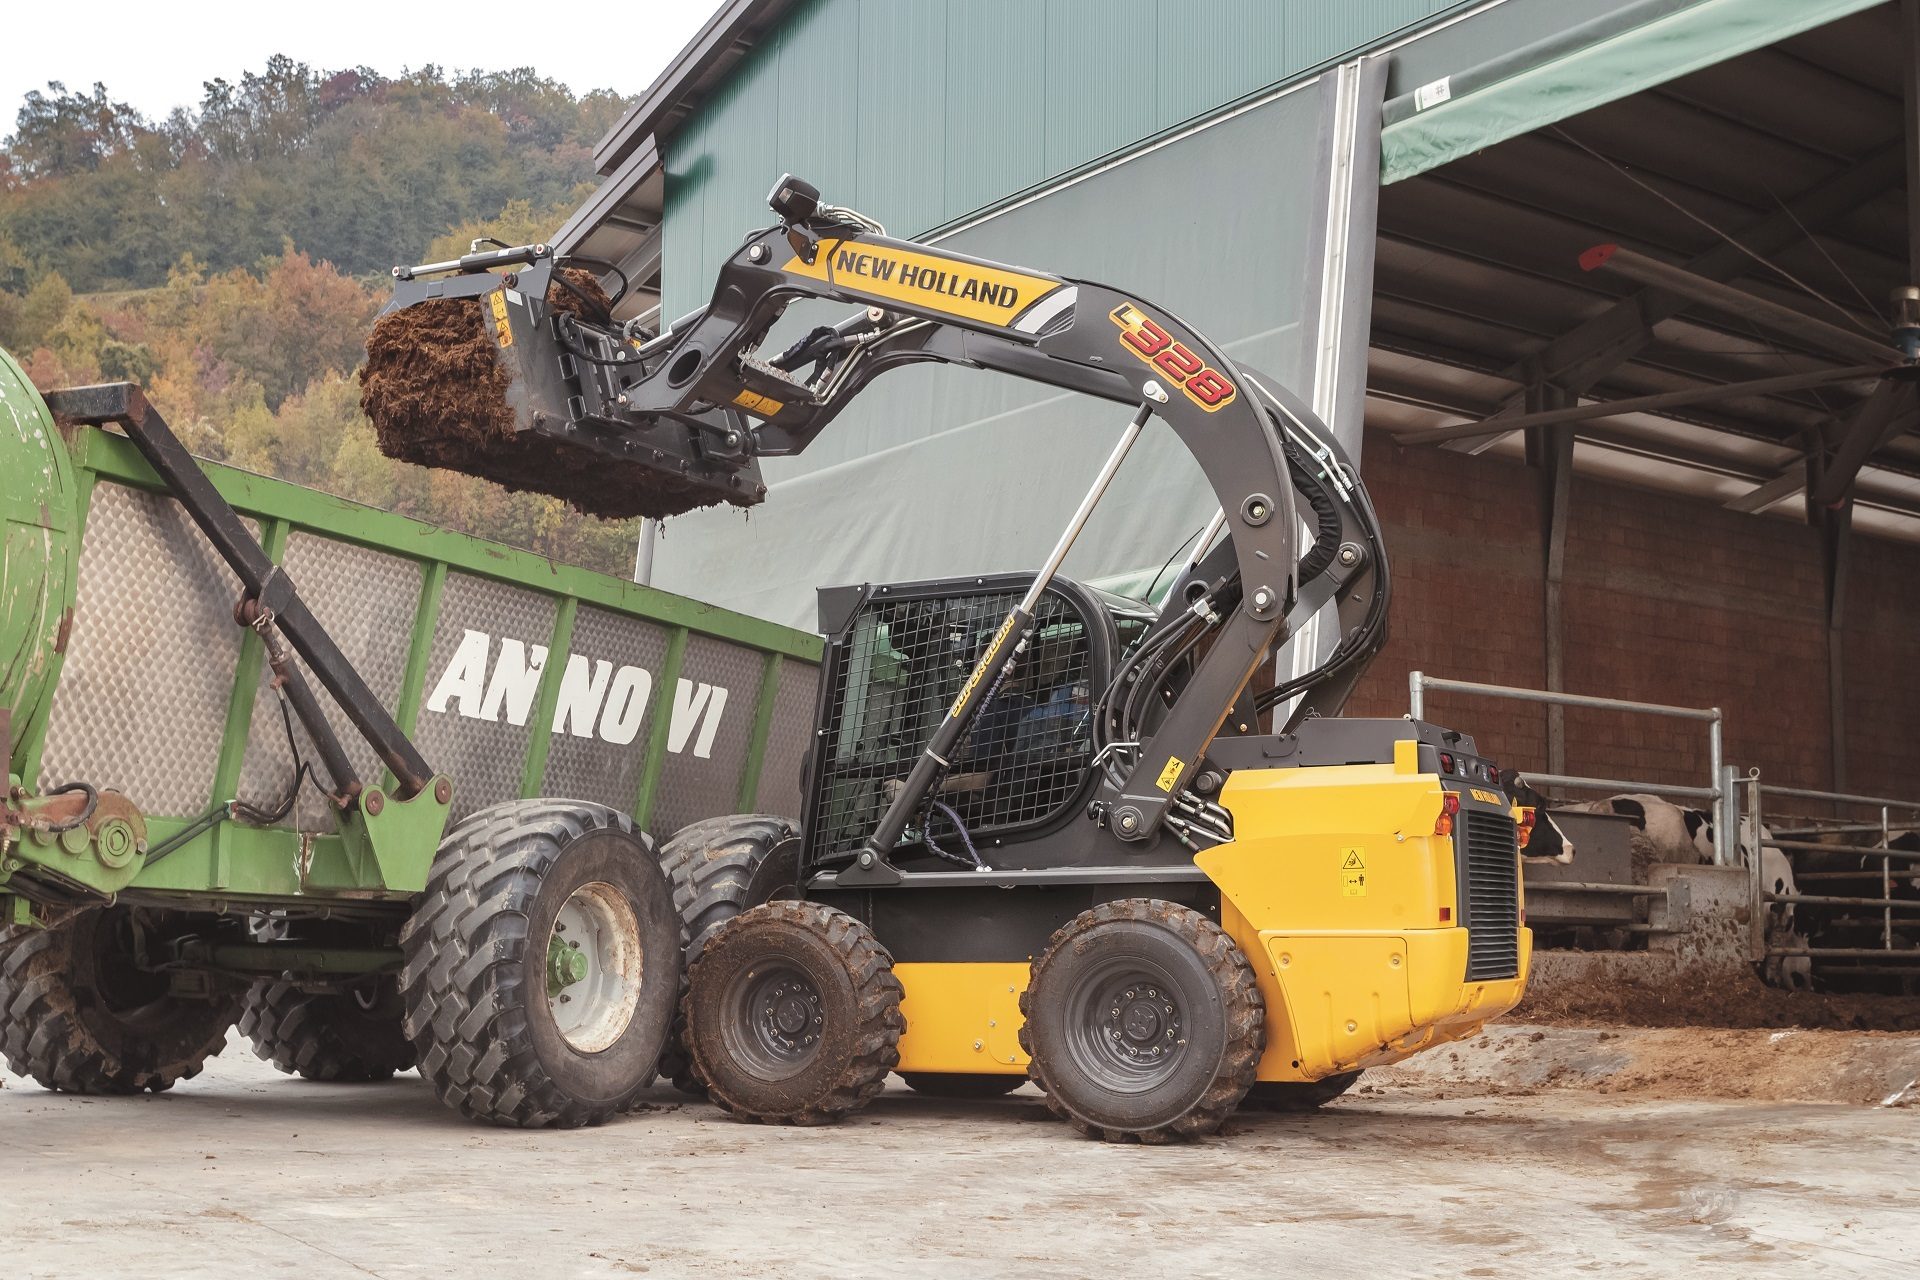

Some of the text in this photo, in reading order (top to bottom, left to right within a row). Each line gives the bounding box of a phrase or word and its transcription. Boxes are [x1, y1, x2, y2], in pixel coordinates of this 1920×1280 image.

[836, 250, 1019, 309] NEW HOLLAND
[1110, 302, 1236, 412] L328
